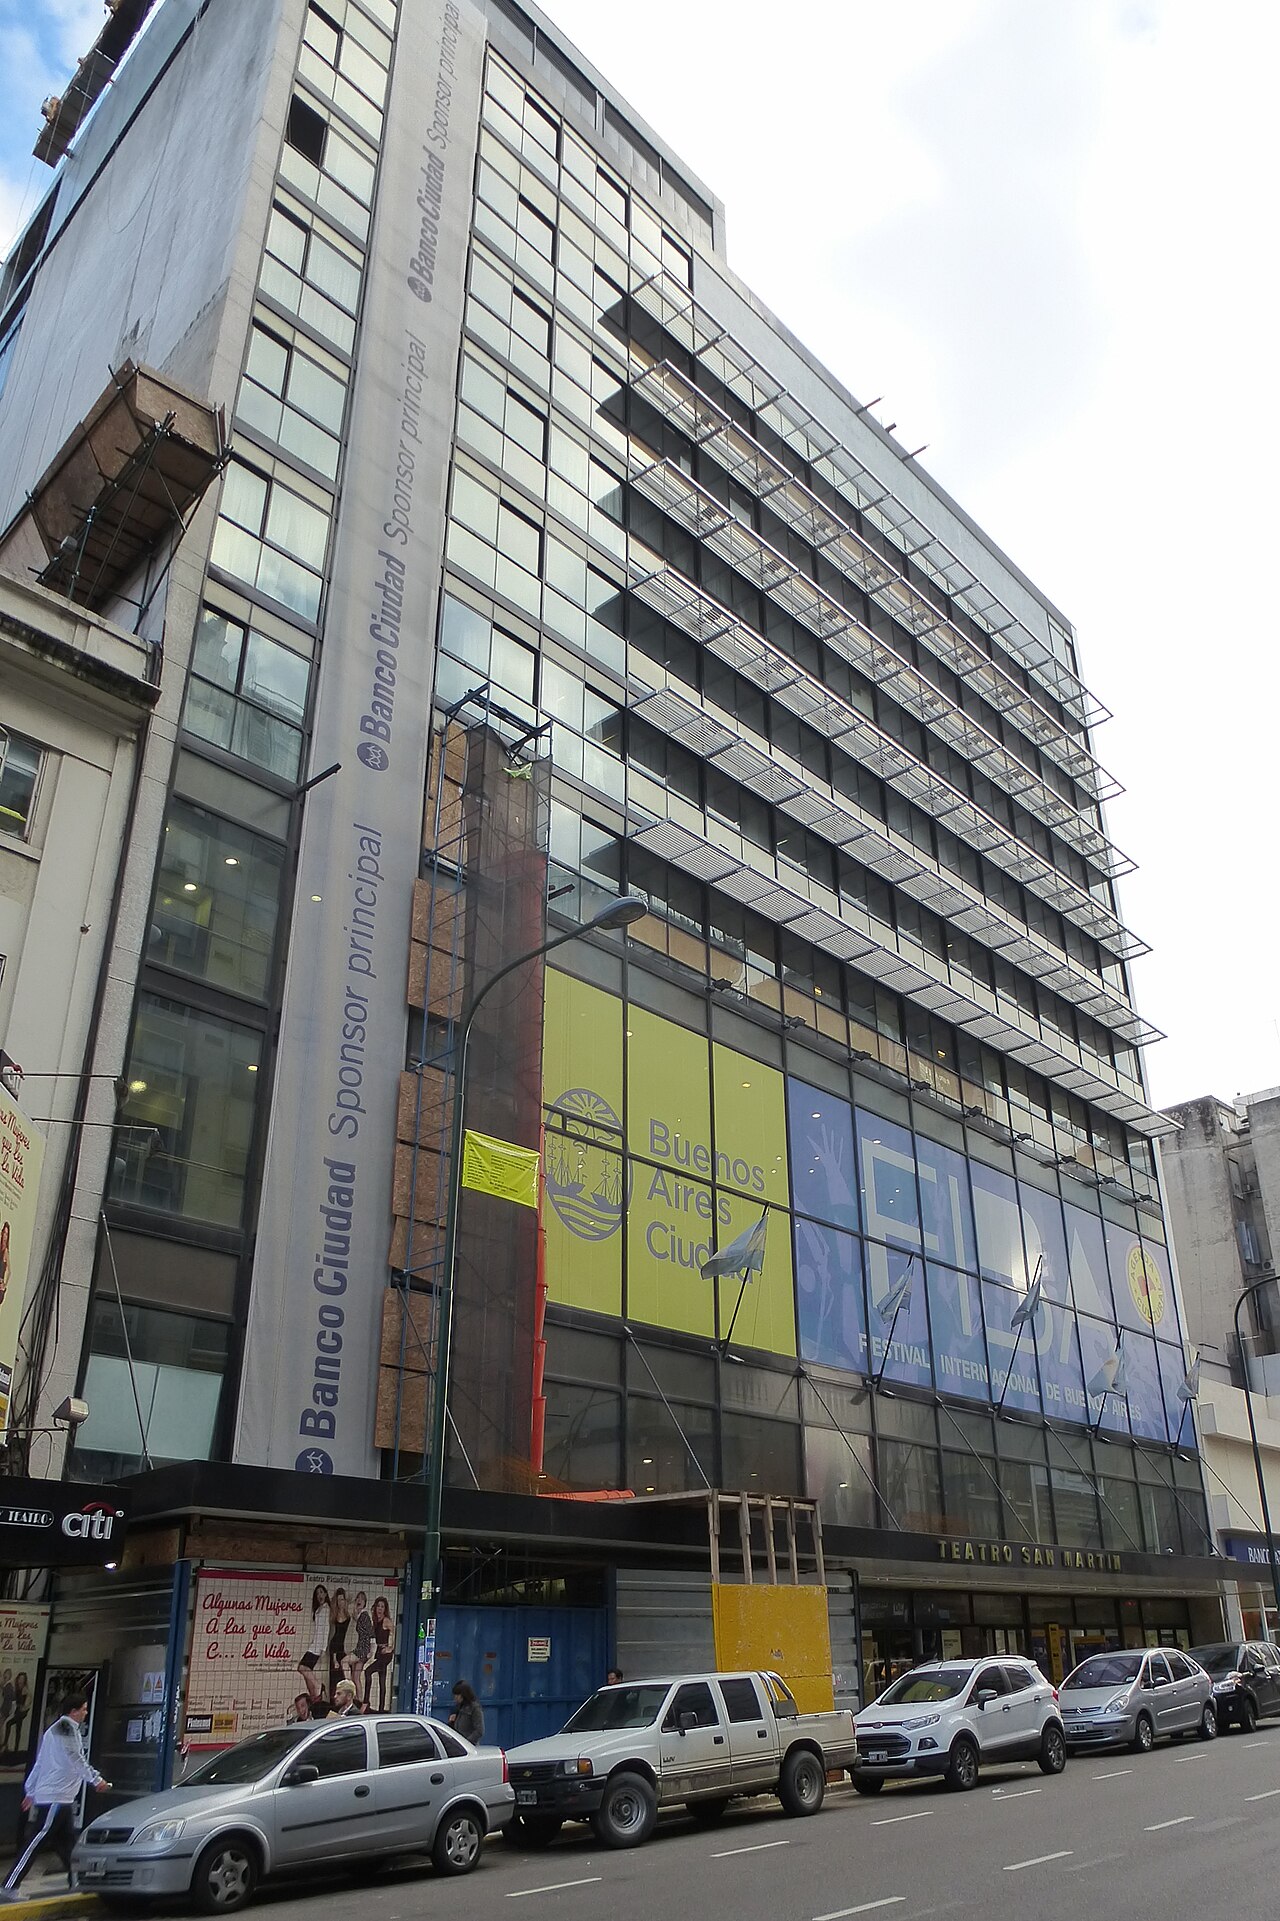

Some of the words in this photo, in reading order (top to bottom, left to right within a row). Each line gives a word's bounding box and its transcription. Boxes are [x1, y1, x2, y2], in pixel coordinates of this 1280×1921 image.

[438, 0, 462, 81] principal
[426, 72, 453, 149] Sponsor
[416, 145, 446, 221] Ciudad
[409, 216, 439, 286] Banco
[397, 329, 429, 445] principal
[383, 439, 416, 546] Sponsor
[369, 549, 406, 649] Ciudad
[359, 649, 398, 744] Banco
[343, 823, 385, 979] principal
[328, 985, 369, 1139] Sponsor
[649, 1118, 765, 1192] Buenos
[312, 1156, 356, 1297] Ciudad
[647, 1168, 732, 1226] Aires
[646, 1221, 754, 1285] Ciud
[861, 1136, 1124, 1366] FIBA
[299, 1304, 345, 1440] Banco
[857, 1333, 931, 1369] FESTIVAL
[1045, 1382, 1061, 1401] DE
[9, 1510, 49, 1525] TEATRO
[61, 1508, 114, 1540] citi
[937, 1540, 1013, 1563] TEATRO
[1021, 1546, 1055, 1566] SAN
[1063, 1551, 1122, 1571] MARTIN
[203, 1593, 253, 1617] Algunas
[255, 1595, 304, 1617] Mujeres
[206, 1618, 219, 1634] A
[223, 1619, 246, 1635] las
[252, 1625, 273, 1640] que
[275, 1619, 296, 1635] les
[242, 1643, 259, 1659] la
[264, 1641, 292, 1660] Vida
